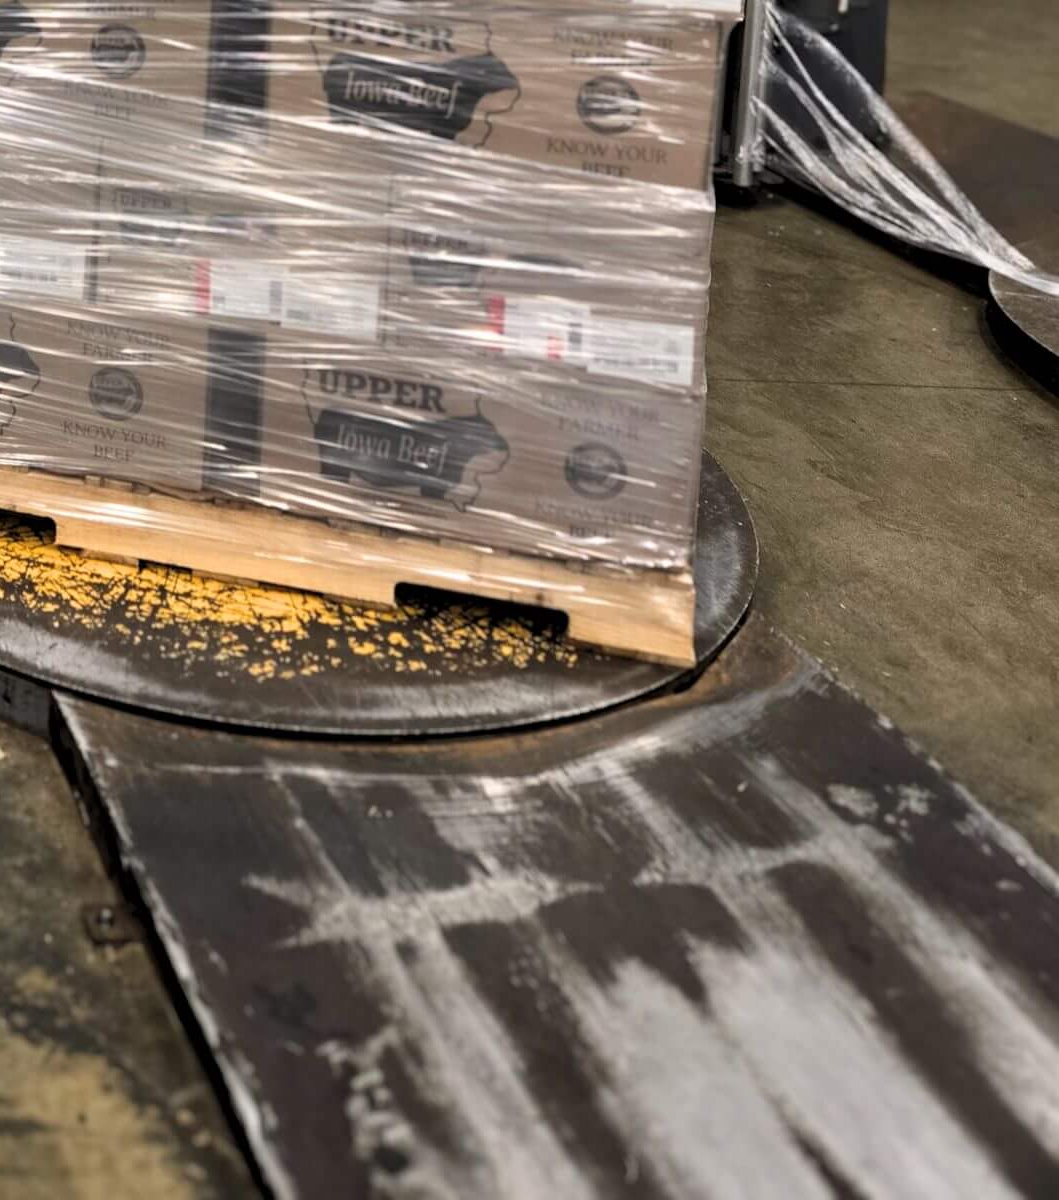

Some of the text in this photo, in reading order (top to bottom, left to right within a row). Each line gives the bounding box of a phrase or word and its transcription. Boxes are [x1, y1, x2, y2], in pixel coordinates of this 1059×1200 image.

[342, 71, 399, 105] Iowa
[546, 137, 668, 165] KNOW YOUR
[316, 368, 447, 414] UPPER
[62, 419, 167, 449] KNOW YOUR
[336, 423, 391, 460] Iowa
